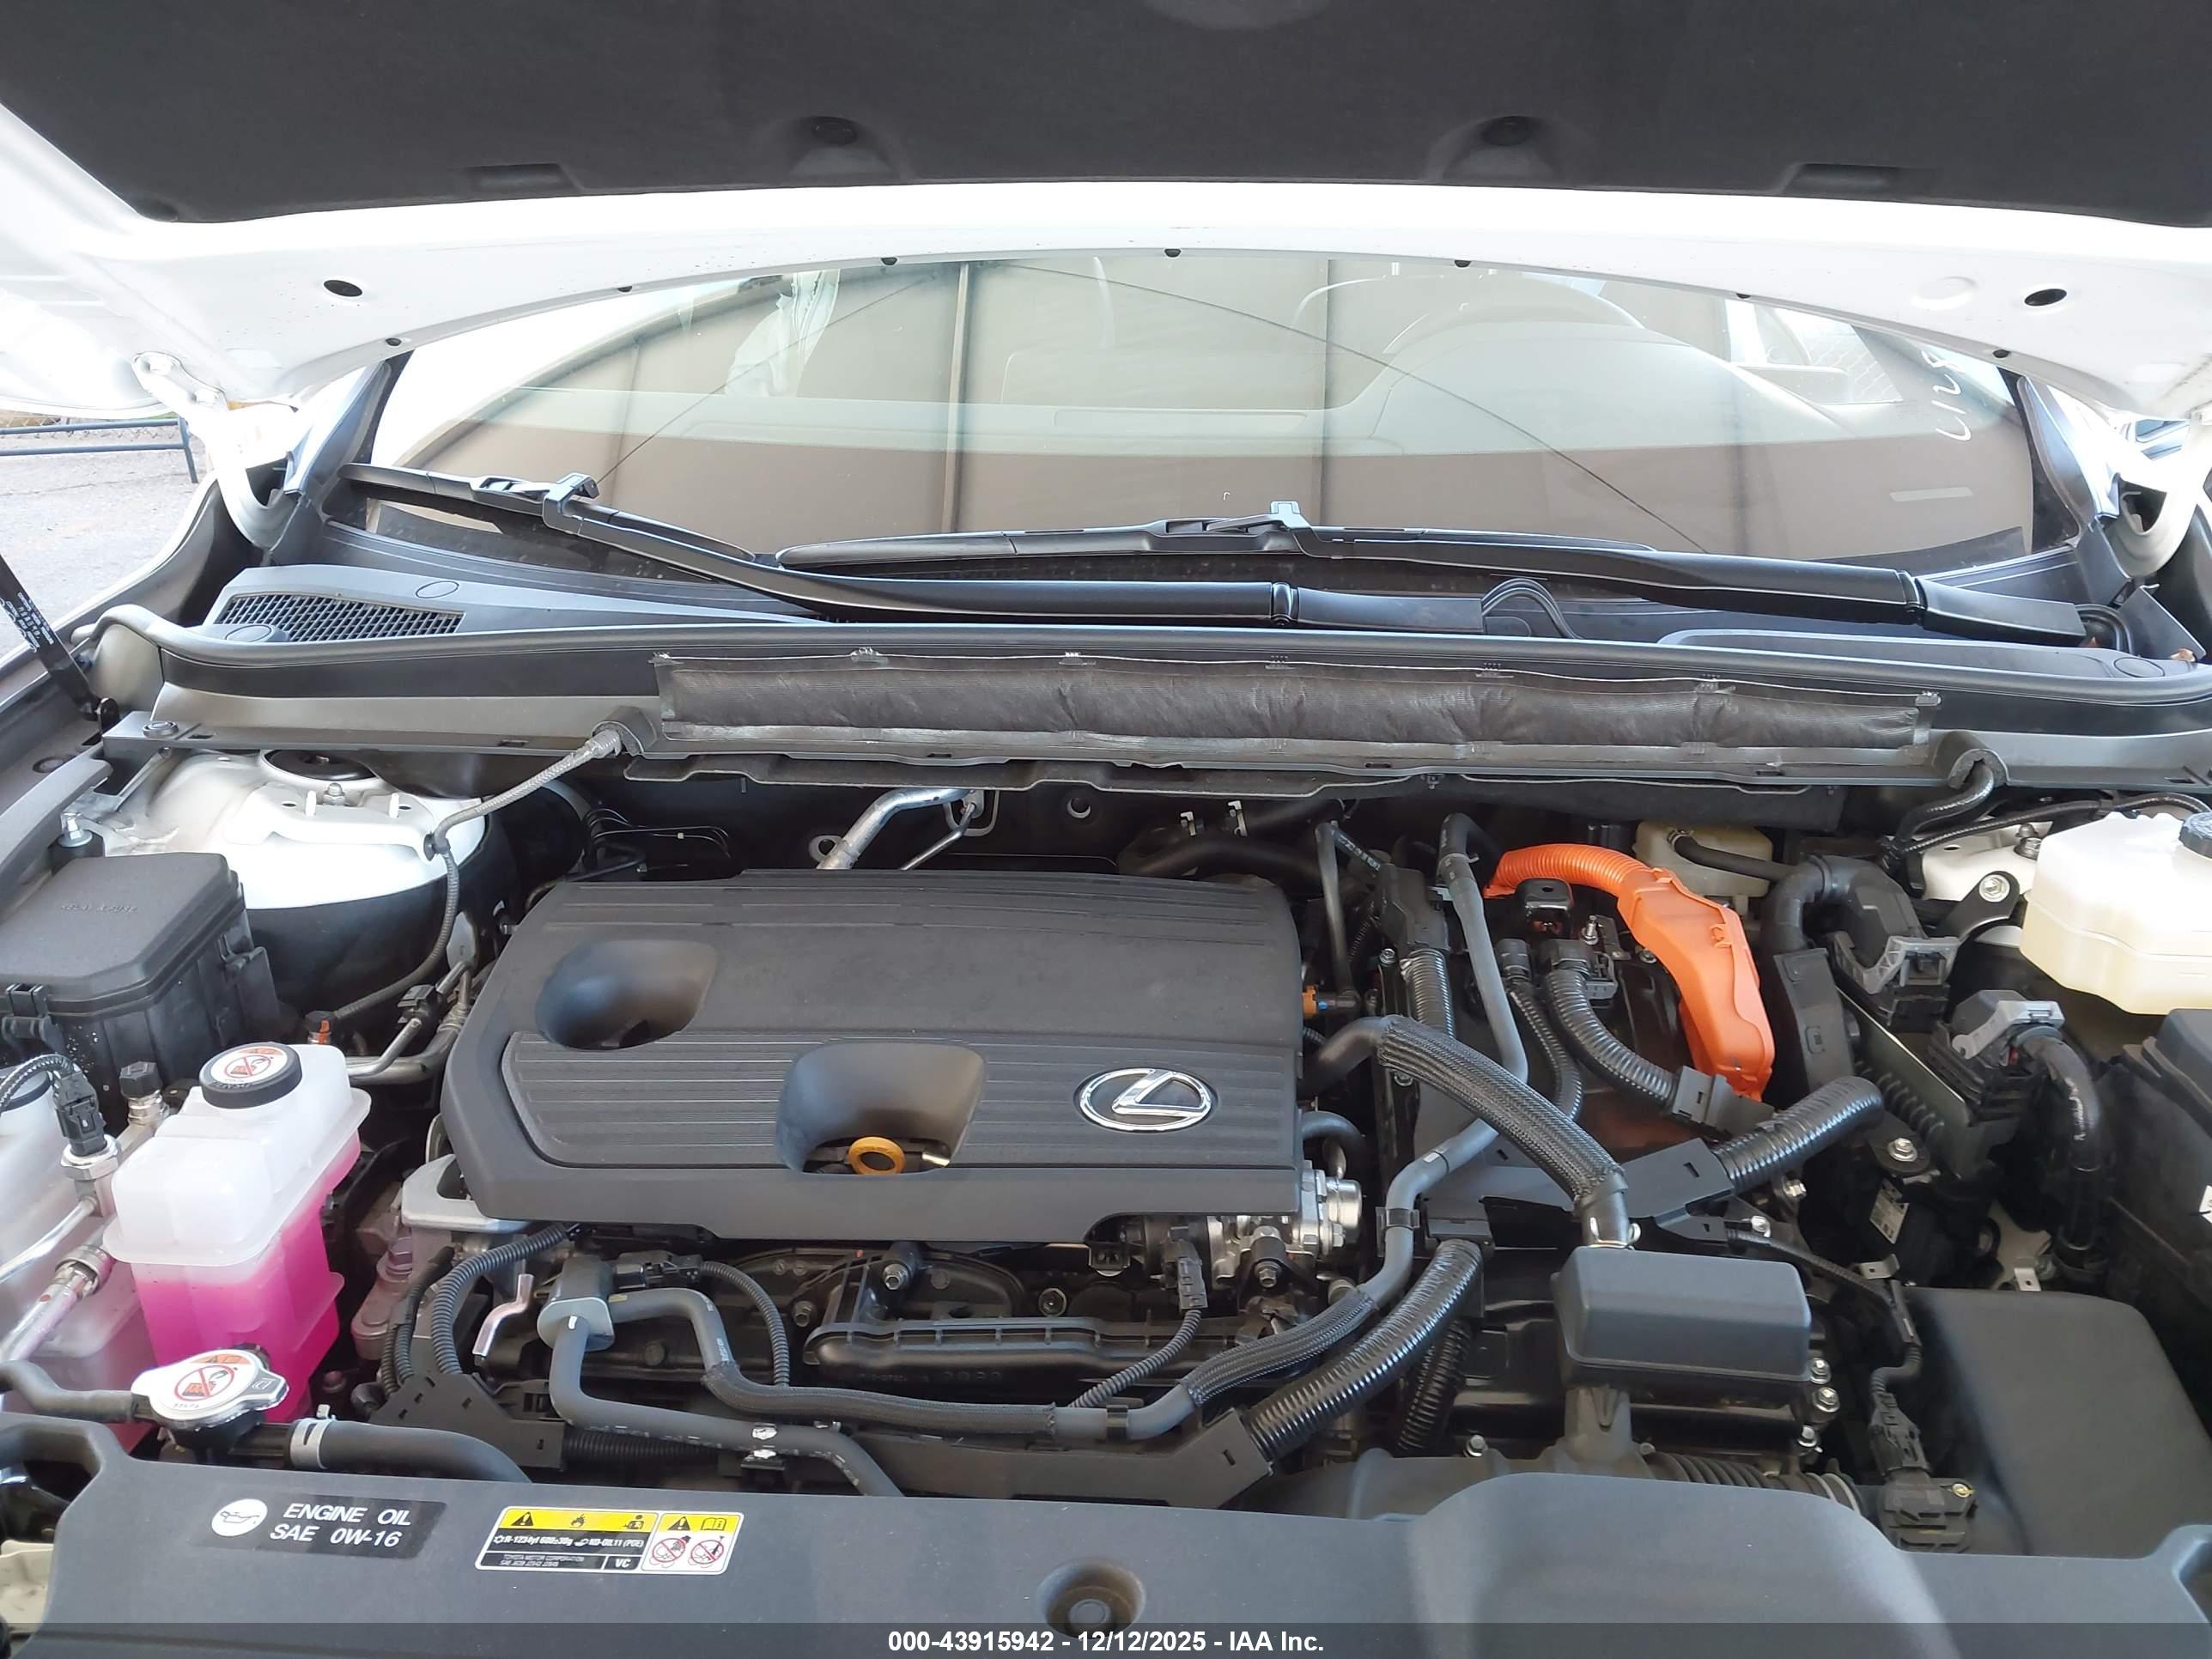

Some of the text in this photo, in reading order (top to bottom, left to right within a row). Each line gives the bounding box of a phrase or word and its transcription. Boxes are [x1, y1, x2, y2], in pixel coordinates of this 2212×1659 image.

[283, 1503, 411, 1526] ENGINE OIL
[270, 1523, 403, 1547] SAE 0W-16
[615, 1559, 633, 1568] VC
